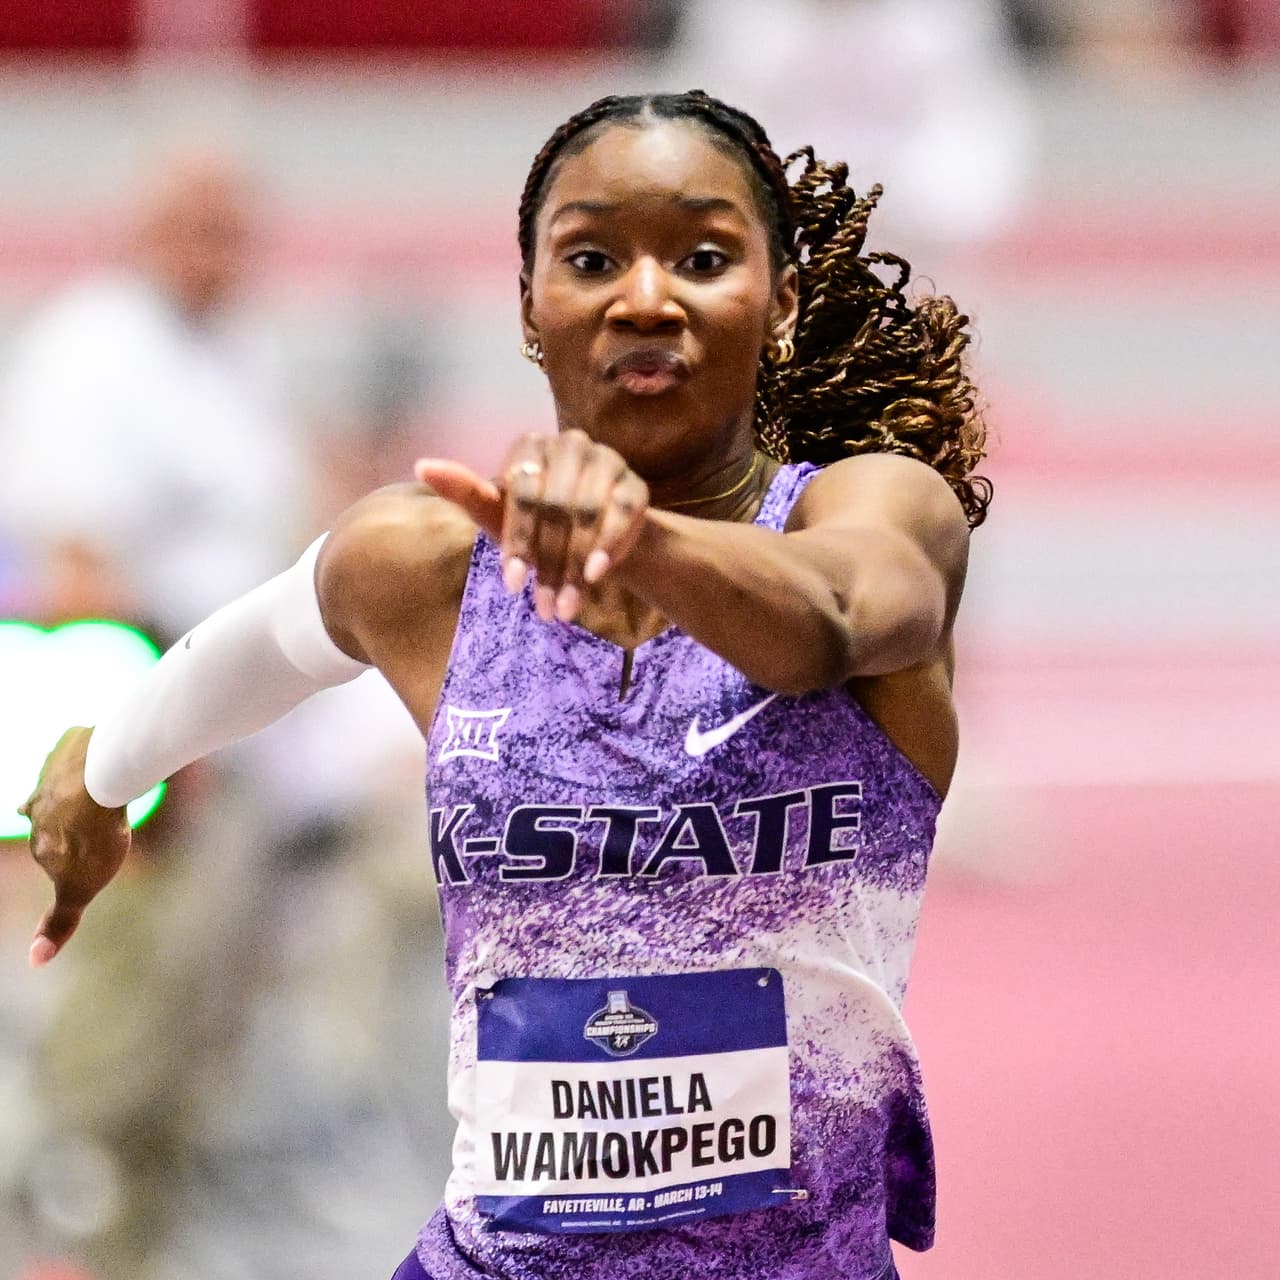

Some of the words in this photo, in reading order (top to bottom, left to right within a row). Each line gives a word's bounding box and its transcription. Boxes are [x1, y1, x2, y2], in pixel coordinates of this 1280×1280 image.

[429, 781, 862, 886] K-STATE
[551, 1073, 713, 1120] DANIELA
[491, 1114, 777, 1181] WAMOKPEGO
[543, 1198, 625, 1213] FAYETTEVILLE,
[627, 1198, 645, 1211] AR
[654, 1188, 693, 1208] MARCH
[695, 1182, 723, 1200] 13-14
